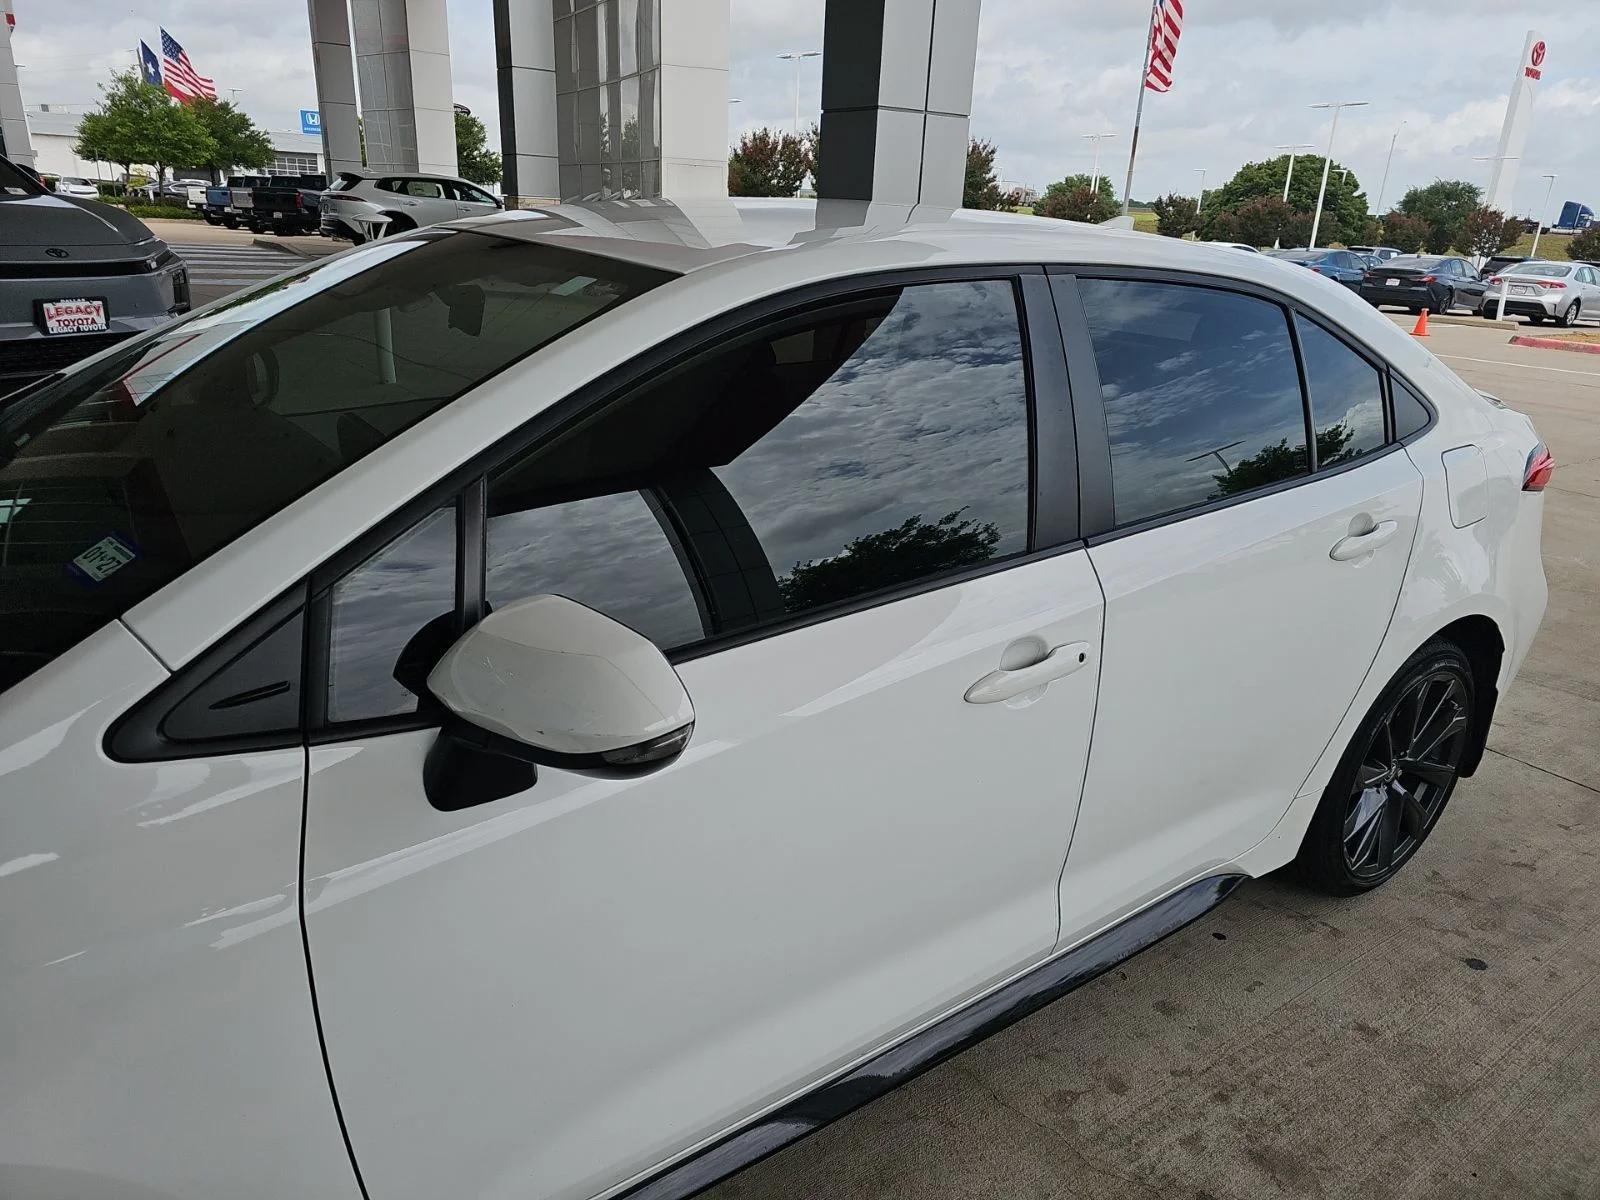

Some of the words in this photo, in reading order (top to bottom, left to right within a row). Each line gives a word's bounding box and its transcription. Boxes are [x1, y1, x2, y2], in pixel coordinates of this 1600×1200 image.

[46, 305, 101, 320] LEGACY
[56, 317, 97, 327] TOYOTA
[96, 557, 122, 573] 27
